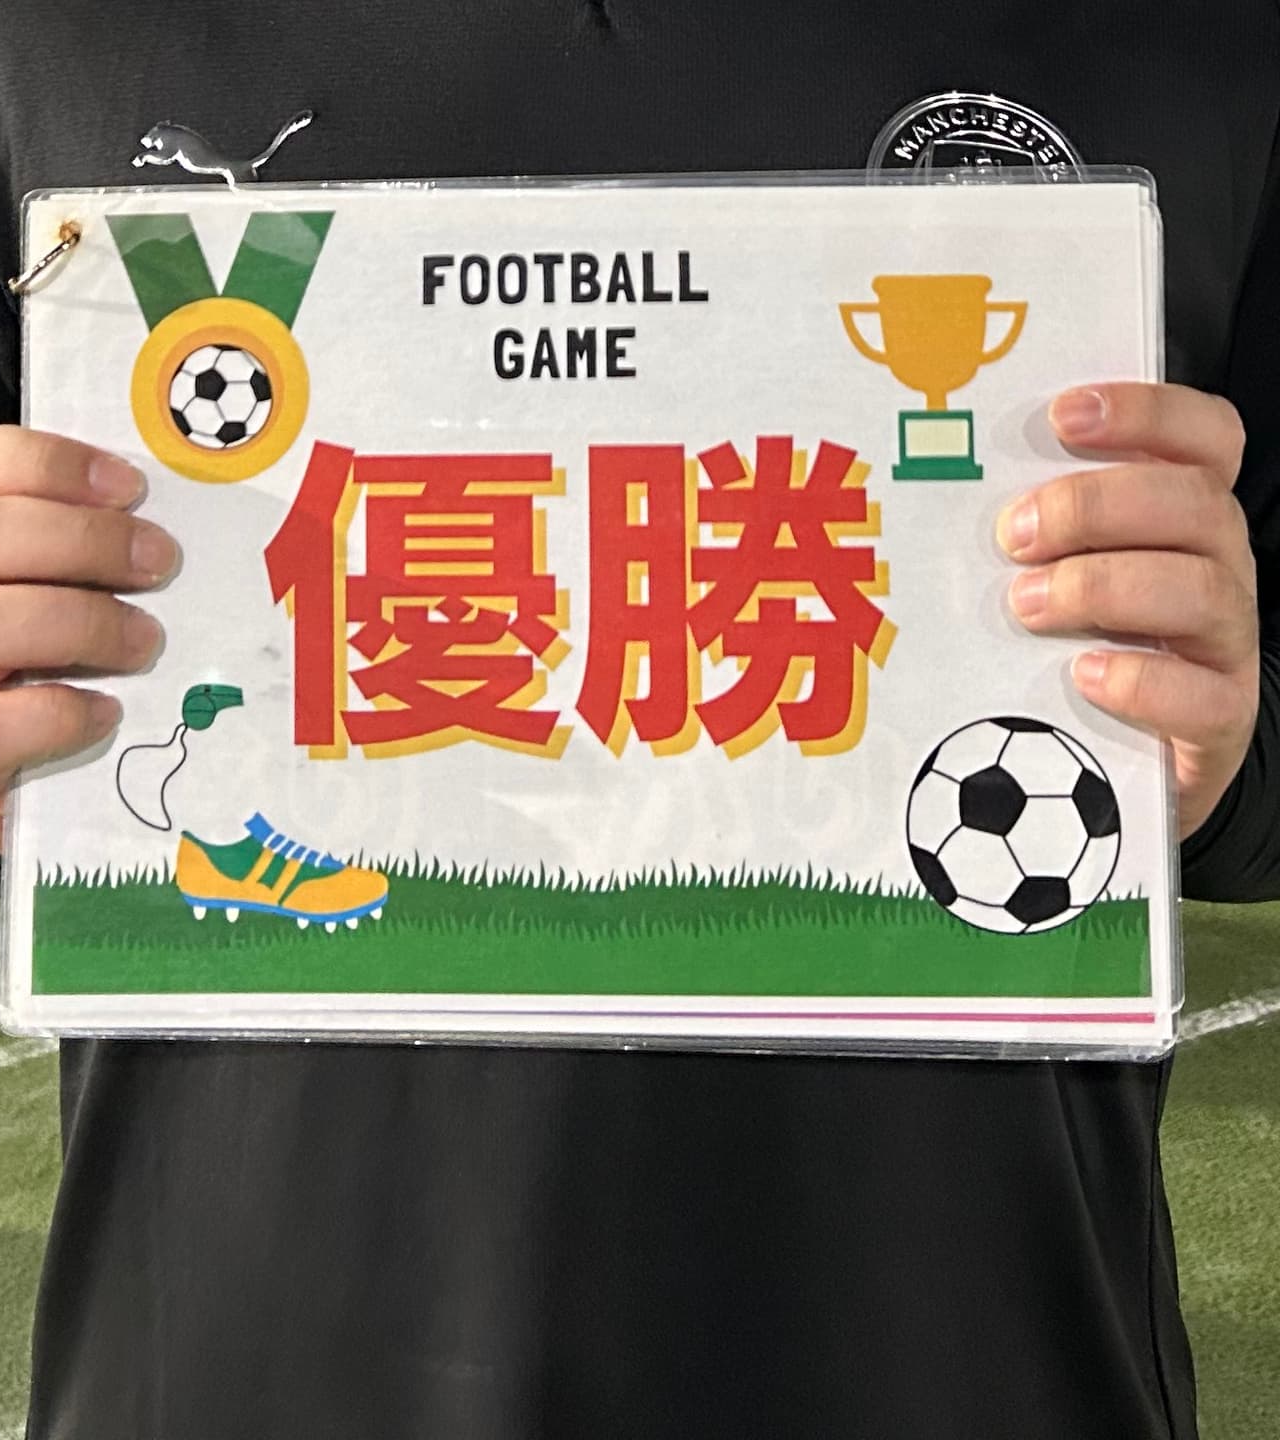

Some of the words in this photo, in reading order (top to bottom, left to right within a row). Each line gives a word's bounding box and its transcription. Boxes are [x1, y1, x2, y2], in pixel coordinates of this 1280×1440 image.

[420, 252, 711, 305] FOOTBALL
[492, 328, 638, 379] GAME
[265, 437, 894, 759] 優勝
